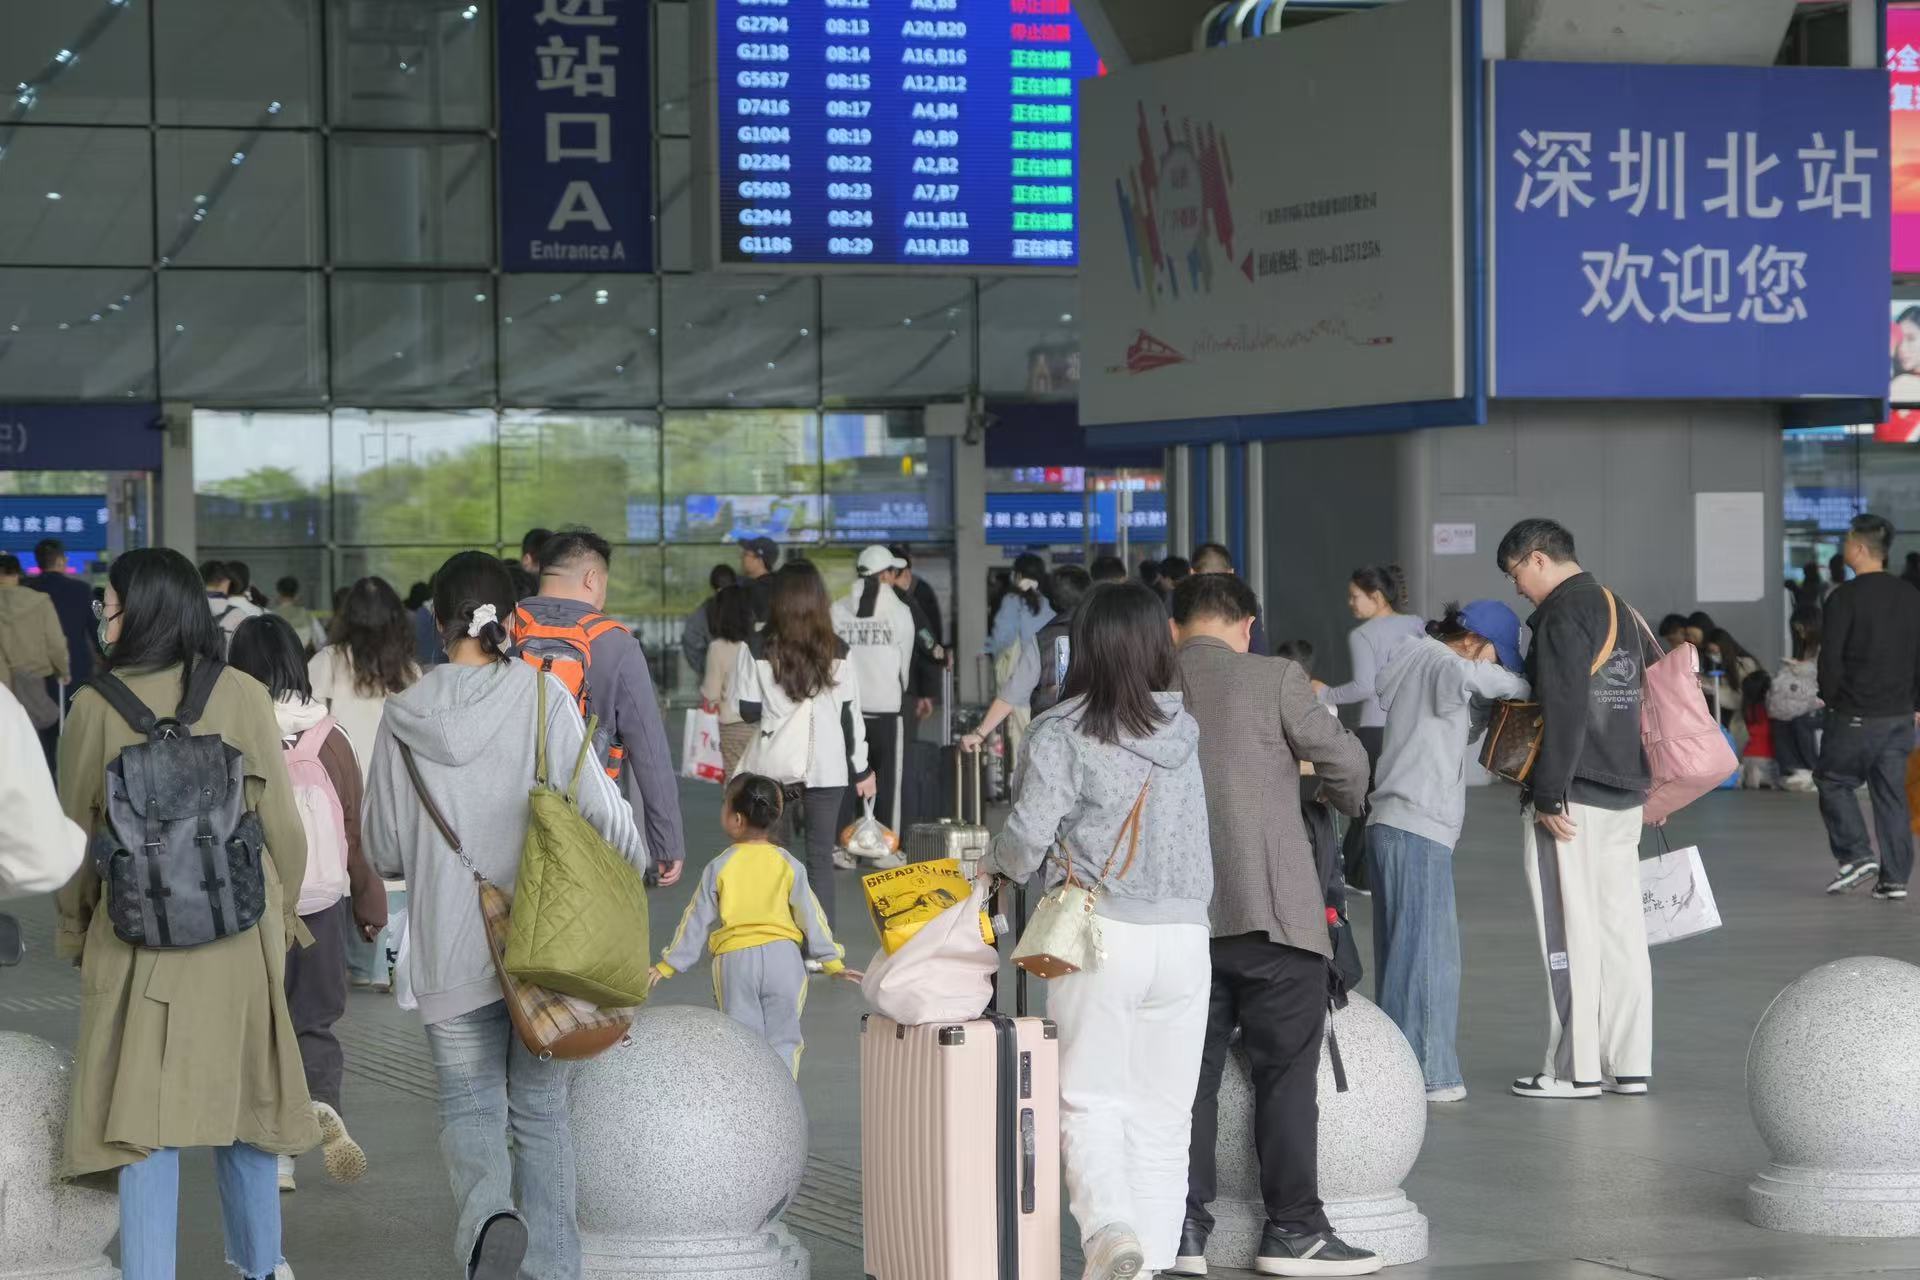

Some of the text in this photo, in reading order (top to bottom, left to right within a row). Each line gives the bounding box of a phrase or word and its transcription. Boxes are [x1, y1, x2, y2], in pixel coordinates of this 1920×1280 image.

[825, 18, 870, 36] 08:13
[901, 20, 967, 39] A20,B20
[825, 45, 871, 63] 08:14
[902, 47, 967, 66] A16,B16
[737, 70, 790, 88] G5637
[826, 73, 871, 90] 08:15
[902, 74, 967, 93] A12,B12
[737, 98, 791, 116] D7416
[826, 100, 872, 118] 08:17
[911, 102, 959, 121] A4,B4
[737, 126, 791, 143] G1004
[826, 127, 872, 145] 08:19
[912, 129, 959, 148] A9,B9
[827, 155, 872, 172] 08:22
[912, 156, 959, 175] A2,B2
[1513, 128, 1878, 219] 深圳北站
[827, 182, 873, 200] 08:23
[913, 183, 960, 202] A7,B7
[827, 210, 873, 227] 08:24
[904, 211, 969, 230] A11,B11
[530, 241, 625, 260] Entrance A
[828, 237, 874, 255] 08:29
[904, 238, 970, 257] A18,B18
[1580, 243, 1808, 324] 欢迎您
[866, 868, 914, 888] BREAD
